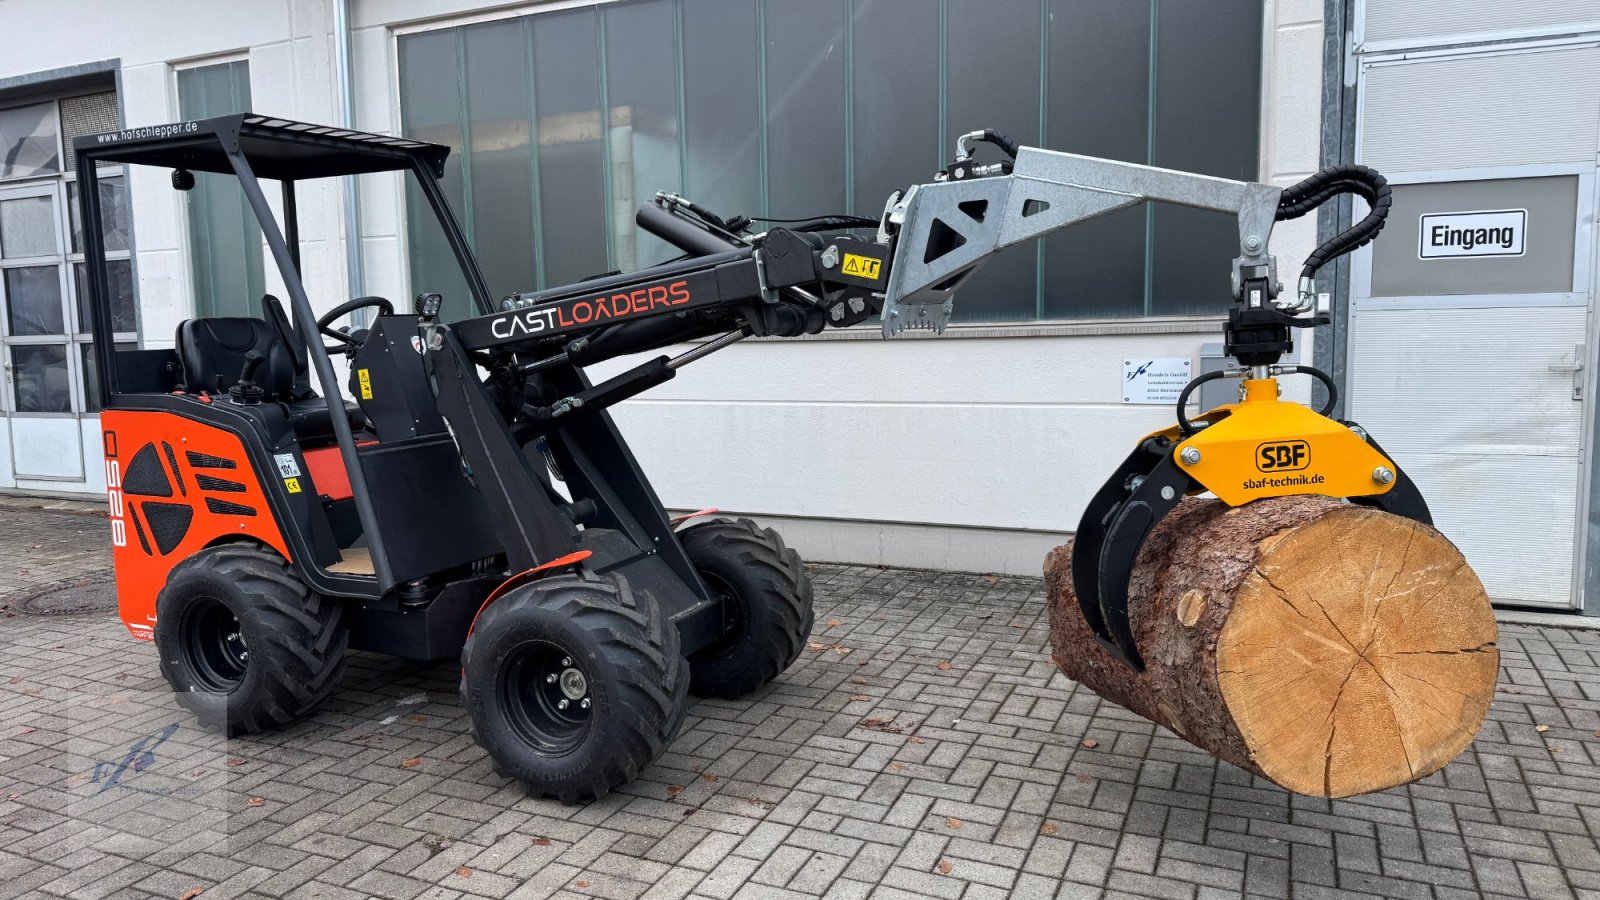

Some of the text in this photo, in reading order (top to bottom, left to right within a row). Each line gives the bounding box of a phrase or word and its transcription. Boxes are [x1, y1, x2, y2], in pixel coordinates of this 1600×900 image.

[97, 120, 198, 143] www.hofschlepper.de
[1431, 225, 1514, 250] Eingang
[1261, 444, 1305, 469] SBF
[1243, 473, 1325, 490] sbaf-technik.de
